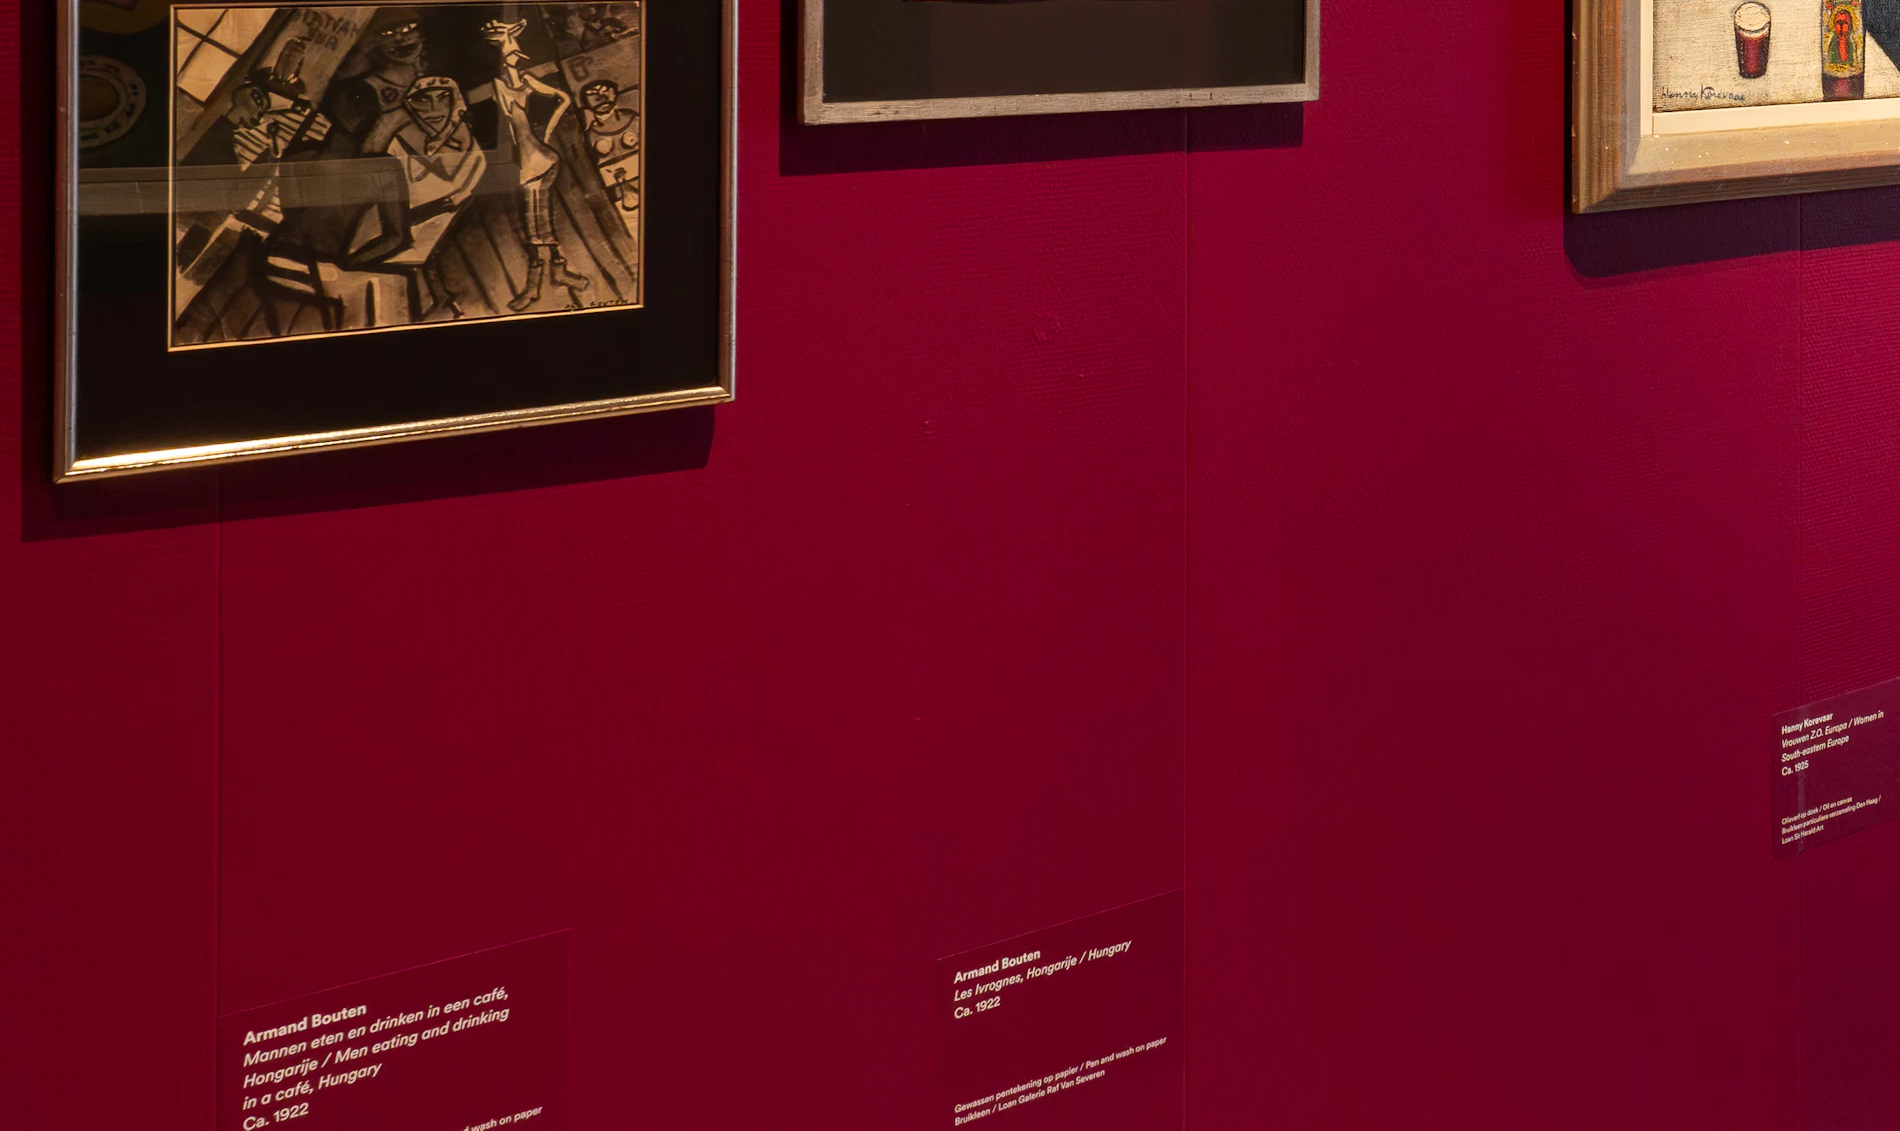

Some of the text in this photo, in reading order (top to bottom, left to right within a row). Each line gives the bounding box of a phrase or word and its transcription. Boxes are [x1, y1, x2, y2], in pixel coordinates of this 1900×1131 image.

[1782, 713, 1833, 734] Hanny Korevaar
[1782, 734, 1809, 748] Vrouwen
[1825, 723, 1847, 735] Europa
[1848, 719, 1853, 728] /
[1854, 714, 1877, 726] Women
[1878, 710, 1884, 719] in
[1782, 735, 1849, 762] South-eastern Europe
[1782, 767, 1793, 776] Ca.
[953, 951, 1041, 984] Armand Bouten
[953, 941, 1132, 1001] Les Ivrognes, Hongarije / Hungary
[242, 1005, 367, 1046] Armand Bouten
[953, 996, 1001, 1019] Ca. 1922
[242, 987, 509, 1067] Mannen eten en drinken in een café,
[242, 1009, 510, 1088] Hongarije / Men eating and drinking
[242, 1063, 383, 1110] in a café, Hungary
[953, 1095, 995, 1113] Gewassen
[995, 1079, 1043, 1101] pentekening
[1042, 1075, 1055, 1083] op
[1054, 1067, 1079, 1081] papier
[1079, 1063, 1085, 1071] /
[1085, 1060, 1100, 1069] Pen
[1099, 1053, 1115, 1064] and
[1115, 1047, 1135, 1059] wash
[1145, 1037, 1167, 1050] paper
[242, 1103, 309, 1131] Ca. 1922
[498, 1116, 513, 1125] on
[513, 1107, 543, 1123] paper
[954, 1070, 1106, 1126] Bruikleen / Loan Galerie Raf Van Severen
